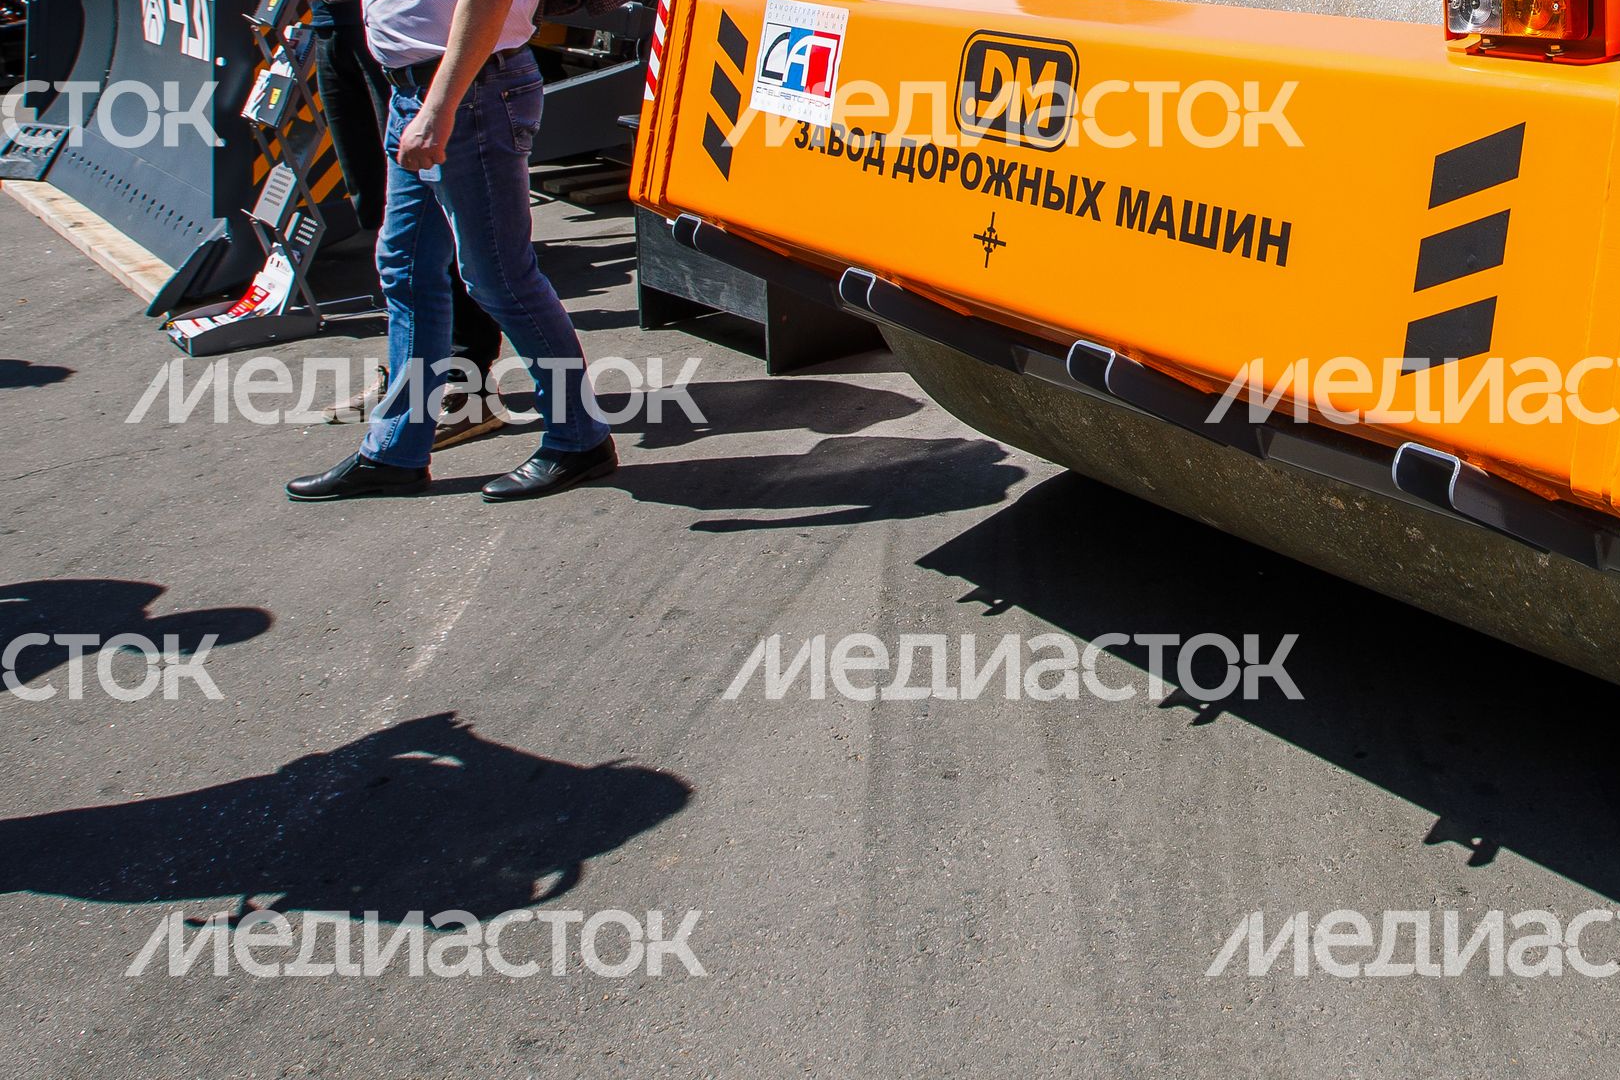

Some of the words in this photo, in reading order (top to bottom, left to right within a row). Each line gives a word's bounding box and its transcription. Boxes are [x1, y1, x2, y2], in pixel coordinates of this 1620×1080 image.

[793, 118, 885, 179] ЗАВОД
[892, 143, 1106, 222] ДОРОЖНЫХ
[1117, 185, 1293, 268] МАШИН
